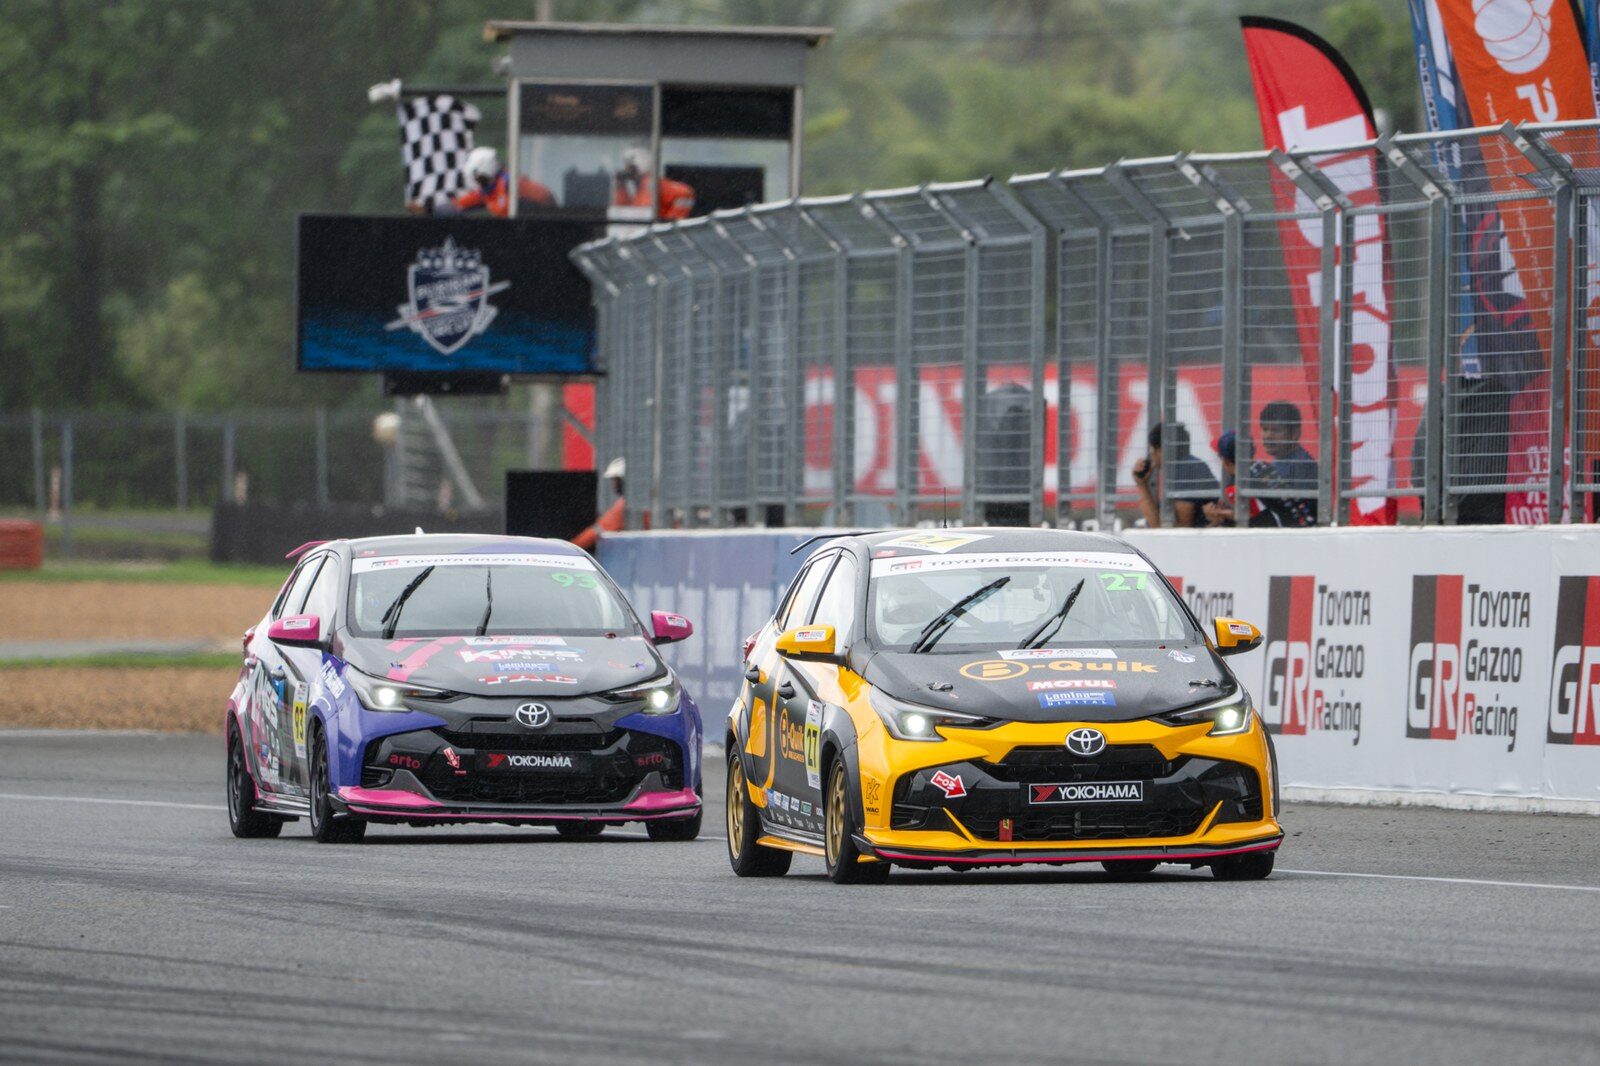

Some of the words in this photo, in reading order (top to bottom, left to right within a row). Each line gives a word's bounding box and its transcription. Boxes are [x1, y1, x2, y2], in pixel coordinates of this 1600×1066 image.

[929, 557, 1000, 567] TOYOTA
[1073, 556, 1134, 568] Racing
[550, 571, 598, 589] 93
[1099, 572, 1148, 592] 27
[1186, 585, 1235, 625] TOYOTA
[1318, 584, 1371, 626] TOYOTA
[1467, 583, 1531, 628] TOYOTA
[960, 659, 1159, 681] B-Quik
[1314, 637, 1365, 679] GAZOO
[1465, 638, 1523, 683] GAZOO
[1031, 679, 1114, 690] MOTUL
[1263, 640, 1311, 726] GR
[1408, 642, 1460, 731] GR
[1311, 689, 1362, 747] Racing
[1462, 692, 1519, 753] Racing
[388, 752, 422, 769] arto
[507, 754, 573, 768] YOKOHAMA
[806, 727, 818, 769] 27
[936, 774, 956, 791] TOW
[1057, 784, 1140, 800] YOKOHAMA
[865, 805, 880, 814] WAC
